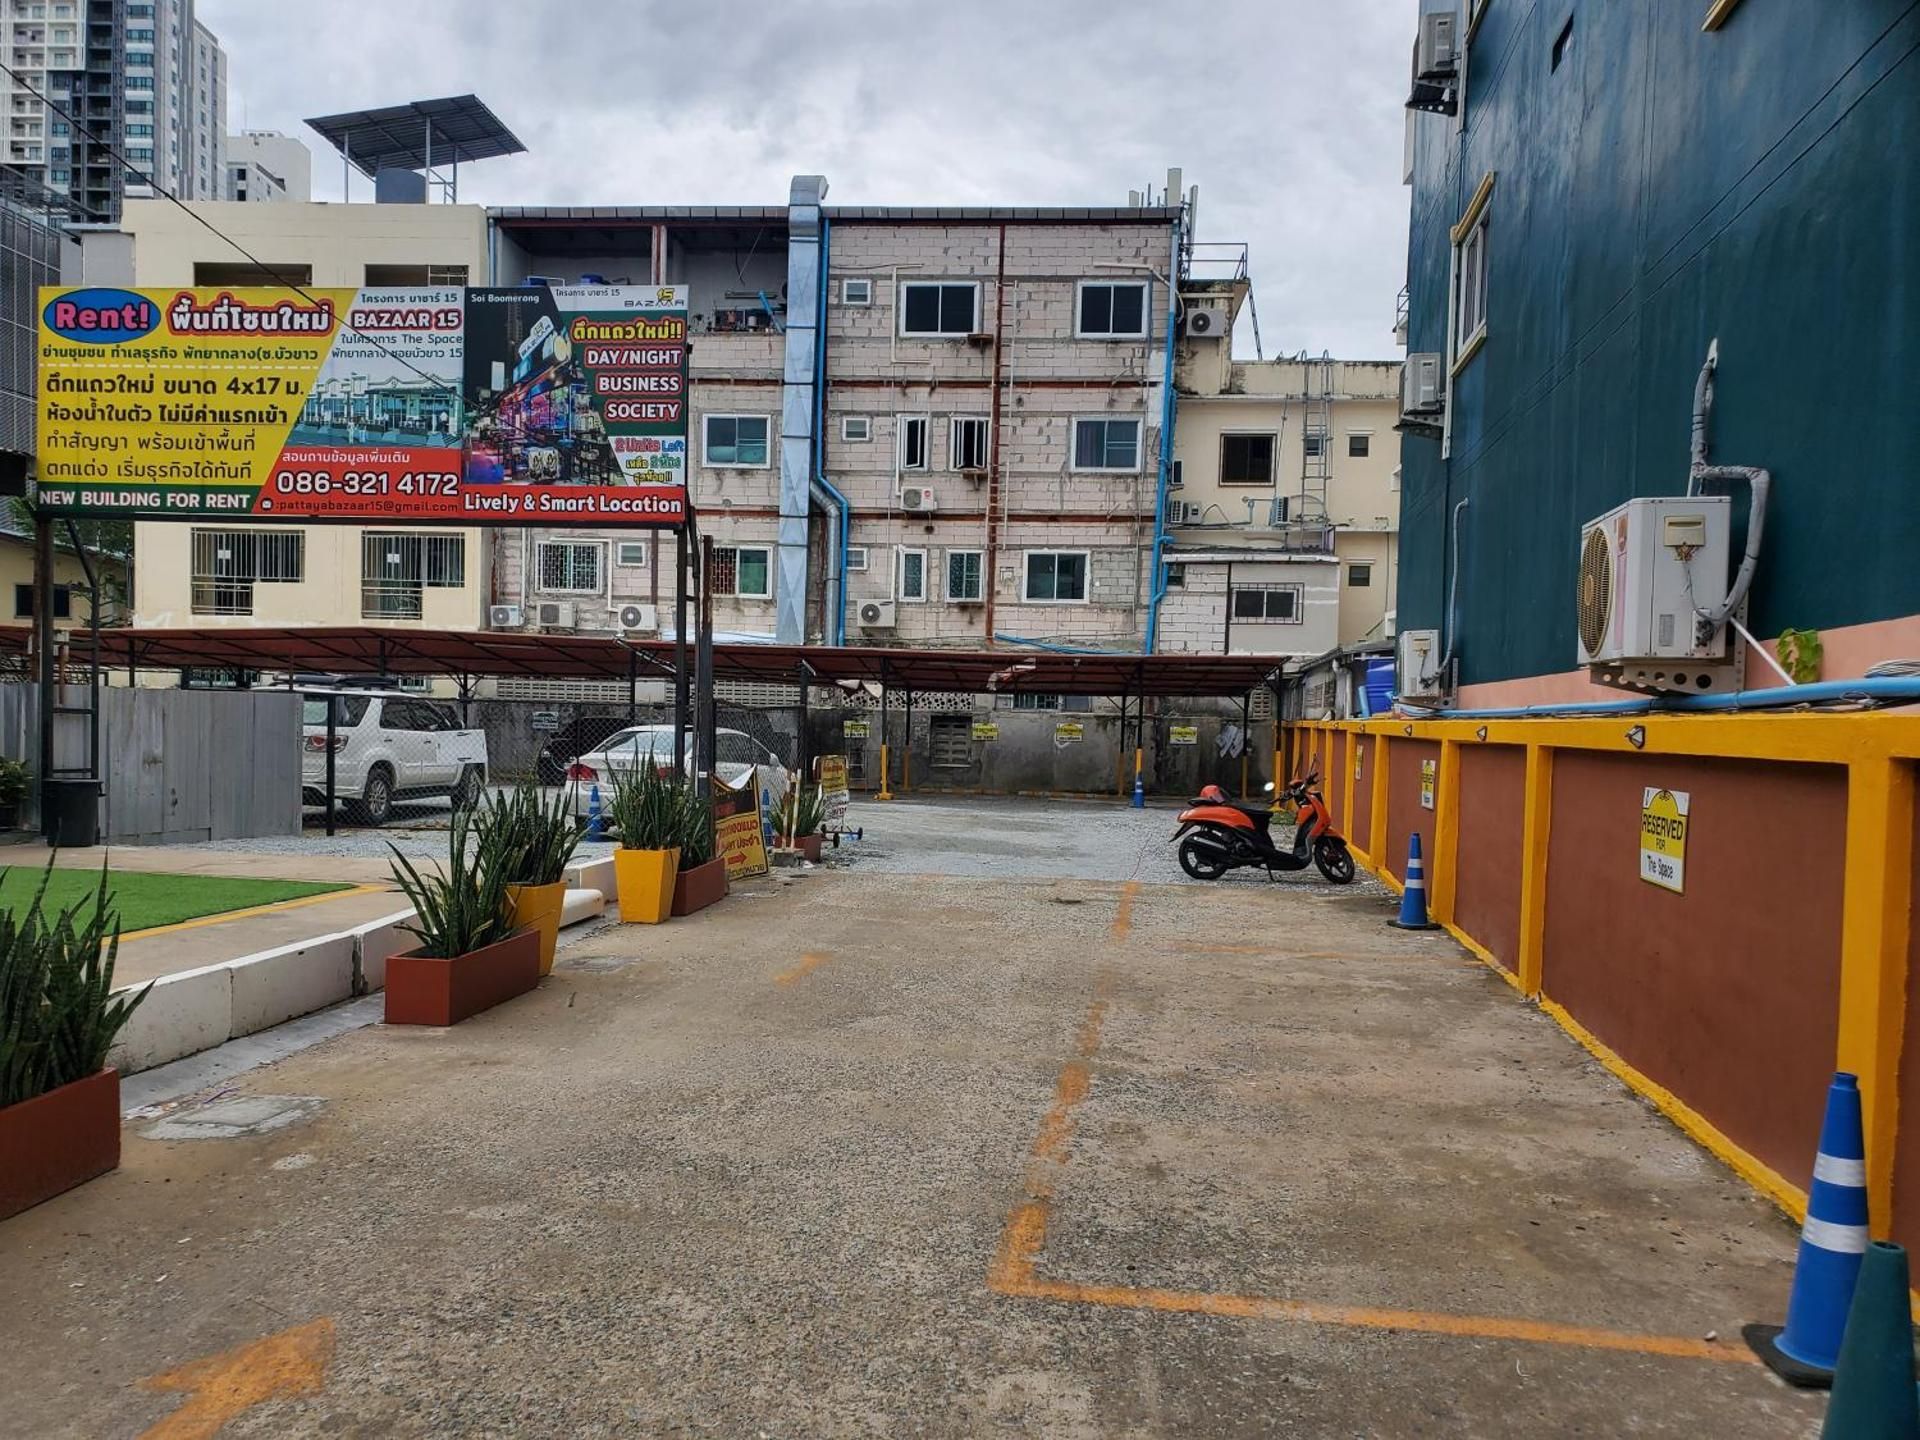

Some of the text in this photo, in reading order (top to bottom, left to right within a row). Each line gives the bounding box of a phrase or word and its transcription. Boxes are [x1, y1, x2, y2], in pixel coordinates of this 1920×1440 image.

[361, 293, 406, 303] โครงการ
[444, 293, 458, 303] 15
[471, 294, 540, 304] Soi Boomerang
[611, 289, 620, 297] 15
[657, 288, 675, 300] 15
[56, 302, 149, 329] Rent!
[172, 298, 329, 330] พื้นที่โซนใหม่
[353, 312, 460, 328] BAZAAR 15
[573, 320, 682, 339] ตึกแถวใหม่!!
[341, 333, 463, 345] ในโครงการ The Space
[43, 344, 105, 361] ย่านชุมชน
[111, 344, 178, 362] ทำเลธุรกิจ
[449, 347, 463, 358] 15
[588, 350, 682, 365] DAY/NIGHT
[46, 372, 304, 395] ตึกแถวใหม่ ขนาด 4x17 ม.
[599, 377, 679, 391] BUSINESS
[47, 397, 287, 424] ห้องน้ำในตัว ไม่มีค่าแรกเข้า
[607, 403, 679, 418] SOCIETY
[47, 428, 256, 452] ทำสัญญา พร้อมเข้าพื้นที่
[282, 448, 410, 466] สอบถามข้อมูลเพิ่มเติม
[47, 456, 252, 482] ตกแต่ง เริ่มธุรกิจได้ทันที
[277, 472, 459, 495] 086-321 4172
[39, 490, 250, 509] NEW BUILDING FOR RENT
[464, 494, 682, 513] Lively & Smart Location
[1641, 814, 1684, 840] RESERVED
[1655, 838, 1666, 852] FOR
